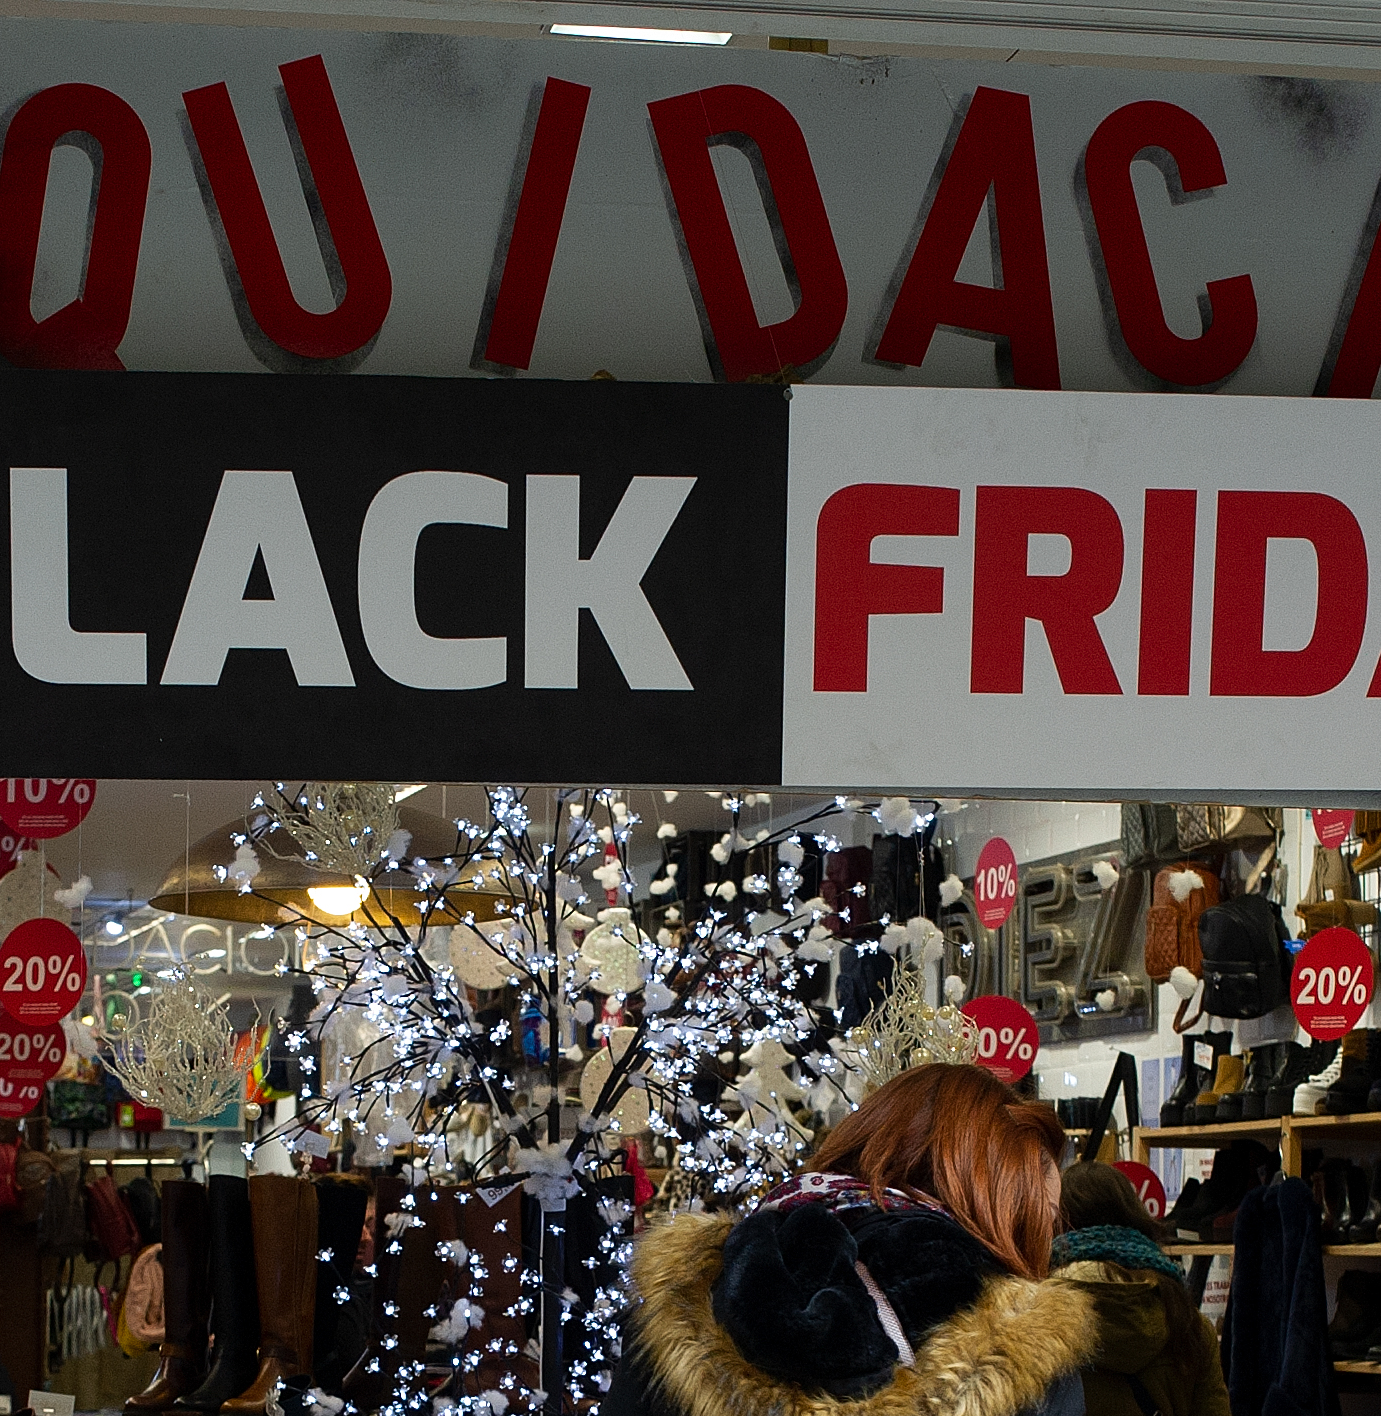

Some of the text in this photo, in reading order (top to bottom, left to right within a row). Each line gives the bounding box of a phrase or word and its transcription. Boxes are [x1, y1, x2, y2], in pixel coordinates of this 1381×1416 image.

[977, 864, 1015, 900] 10%
[3, 955, 80, 992] 20%
[1297, 966, 1366, 1004] 20%
